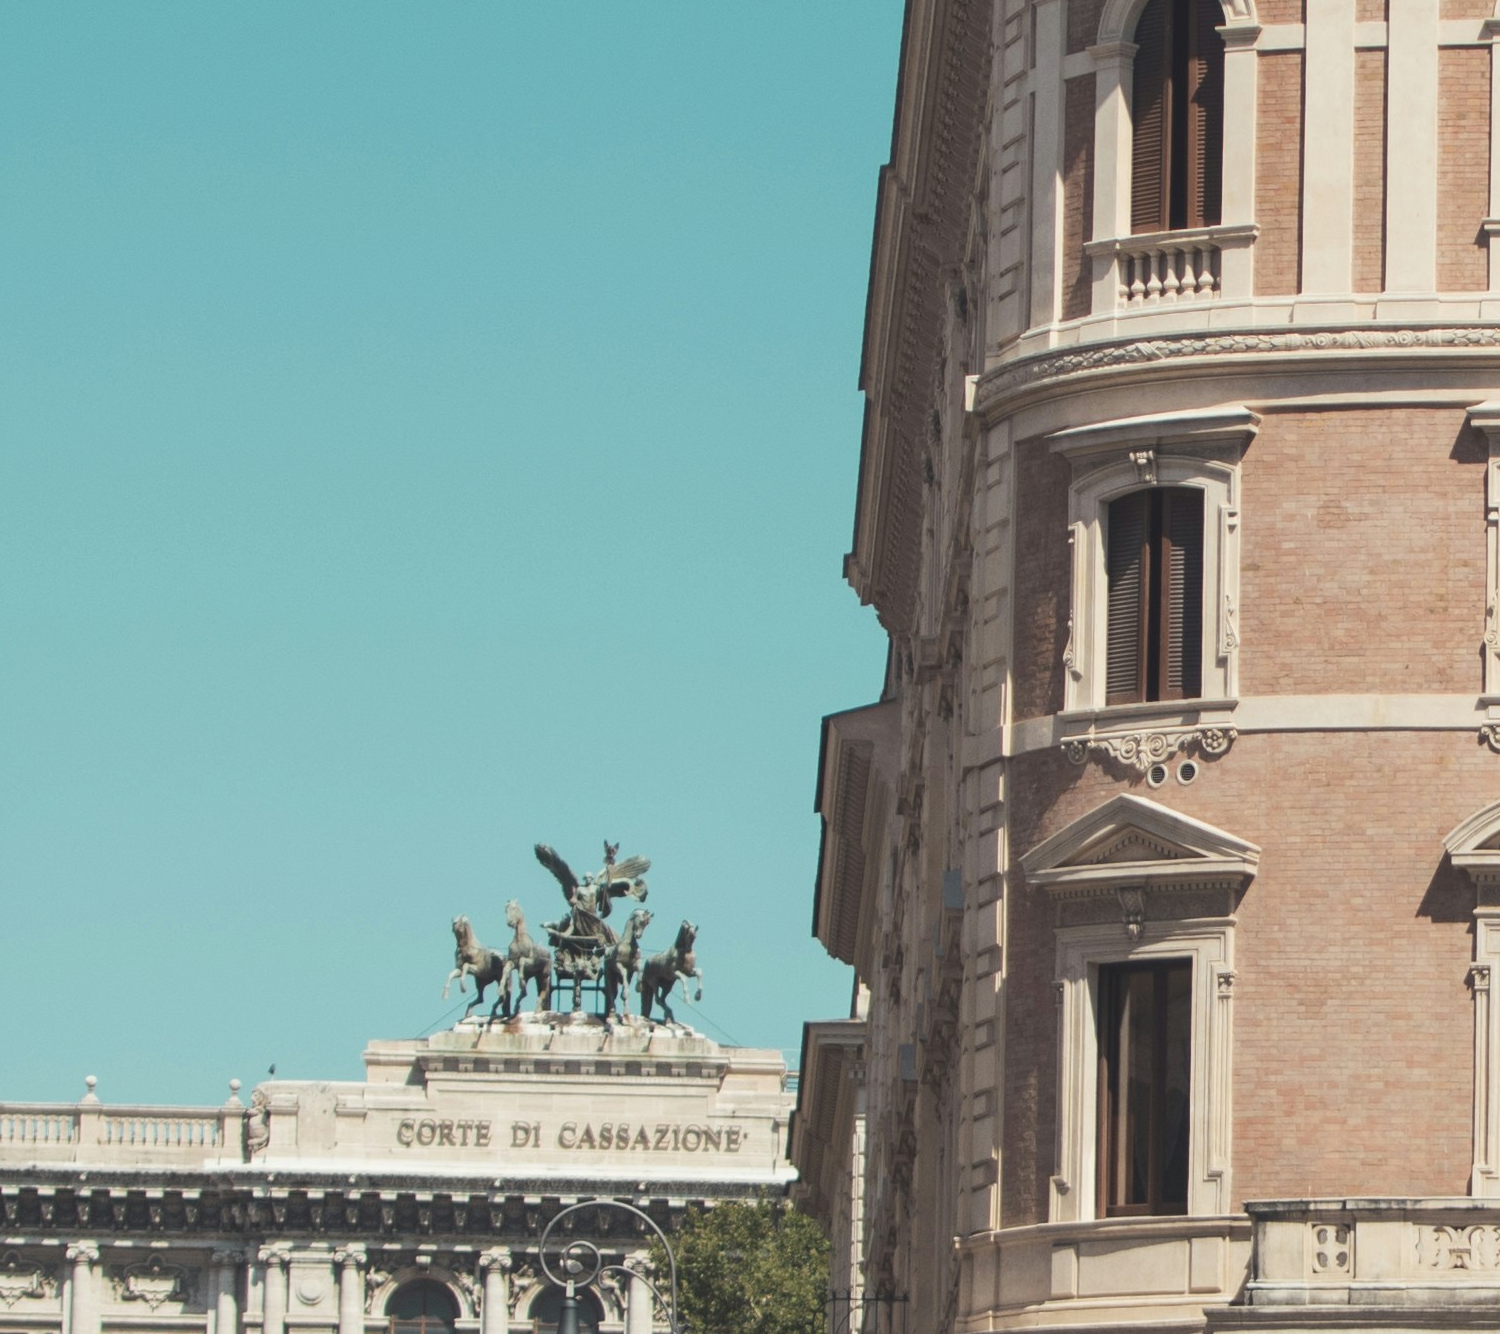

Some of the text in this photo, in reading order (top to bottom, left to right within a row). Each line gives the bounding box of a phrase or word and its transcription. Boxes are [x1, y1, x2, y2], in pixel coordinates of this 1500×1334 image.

[397, 1118, 743, 1153] CORTE DI CASSAZIONE
